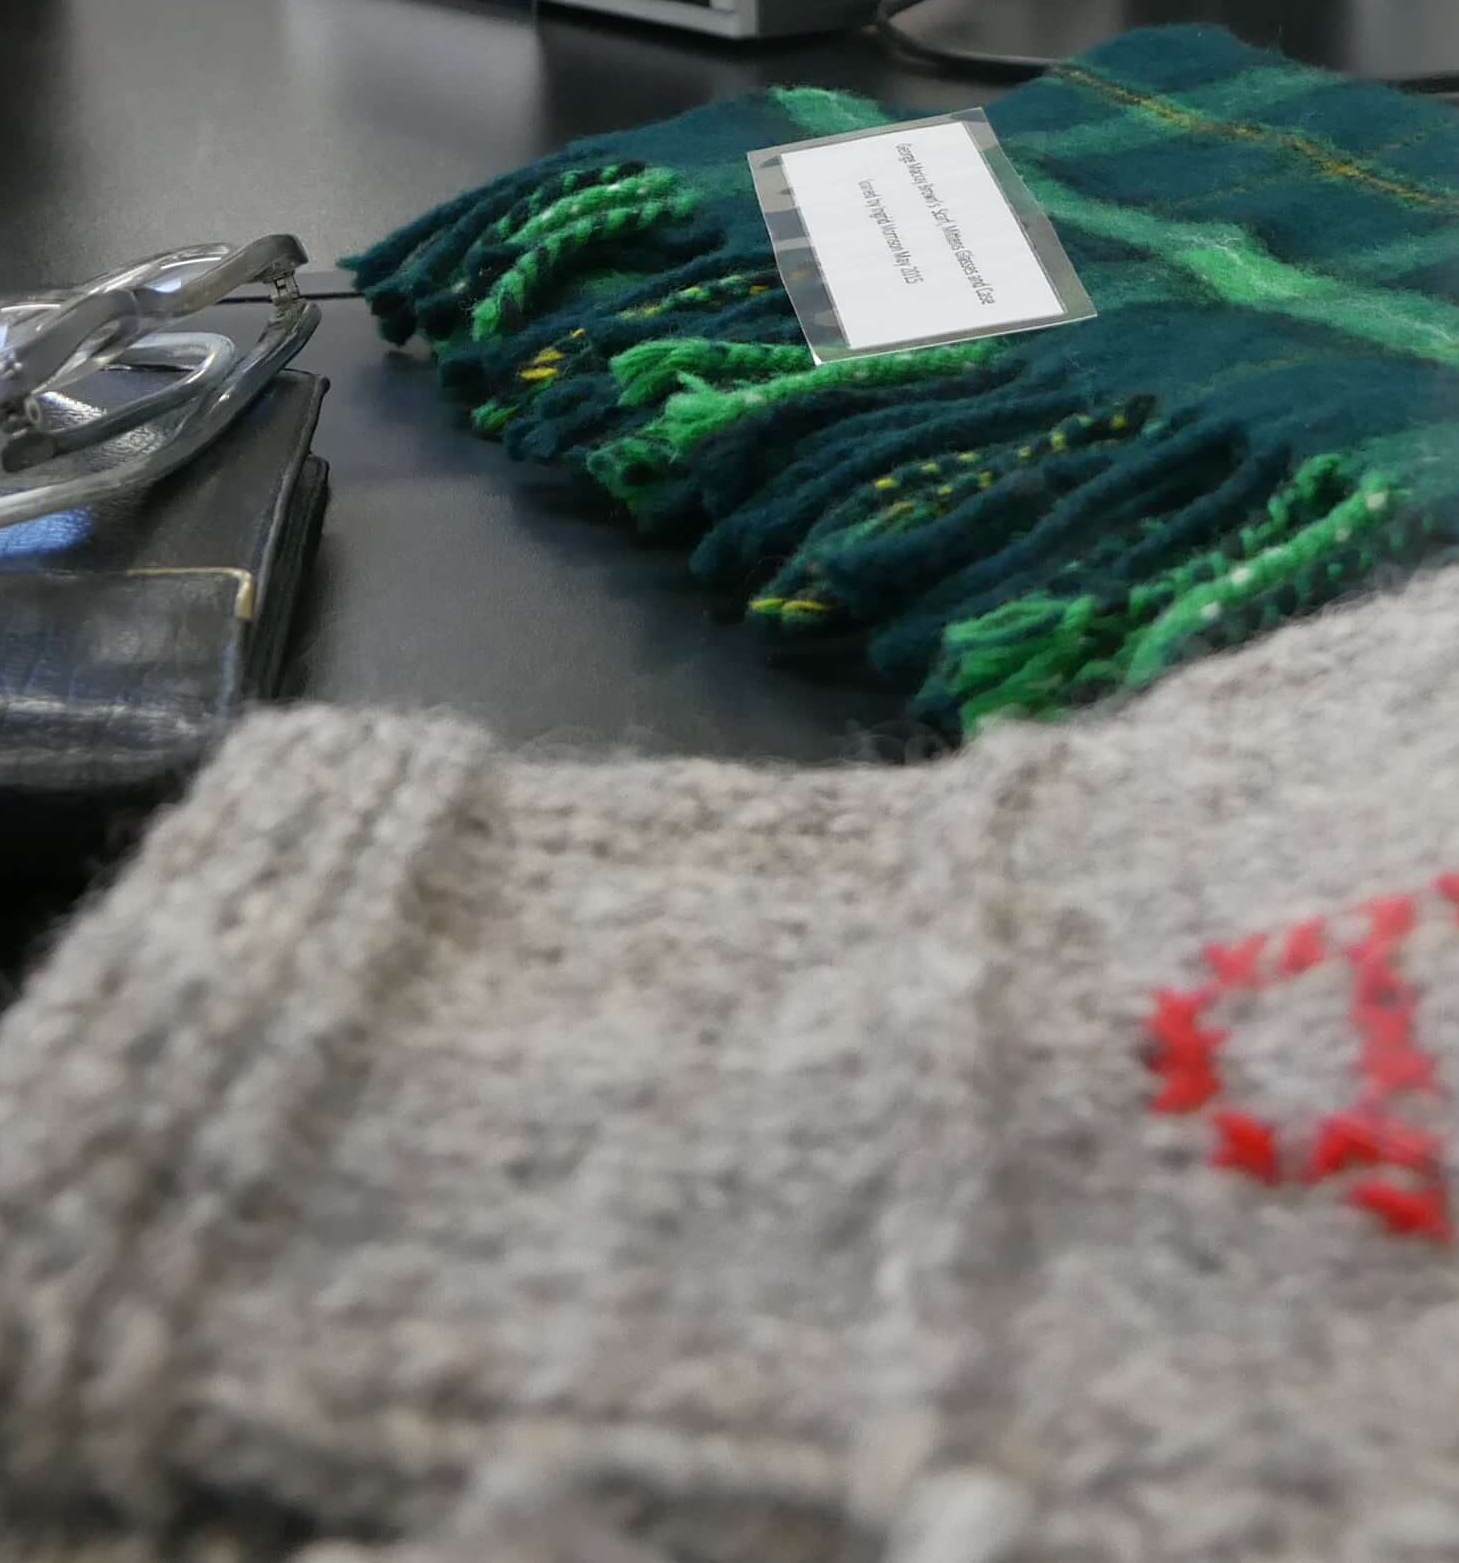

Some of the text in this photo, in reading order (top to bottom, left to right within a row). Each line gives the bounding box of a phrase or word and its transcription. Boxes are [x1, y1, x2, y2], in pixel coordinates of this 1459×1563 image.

[896, 143, 917, 165] George
[894, 250, 912, 267] May
[955, 249, 979, 275] Glasses
[901, 266, 925, 285] 2015
[968, 274, 989, 289] and
[976, 287, 996, 306] Case
